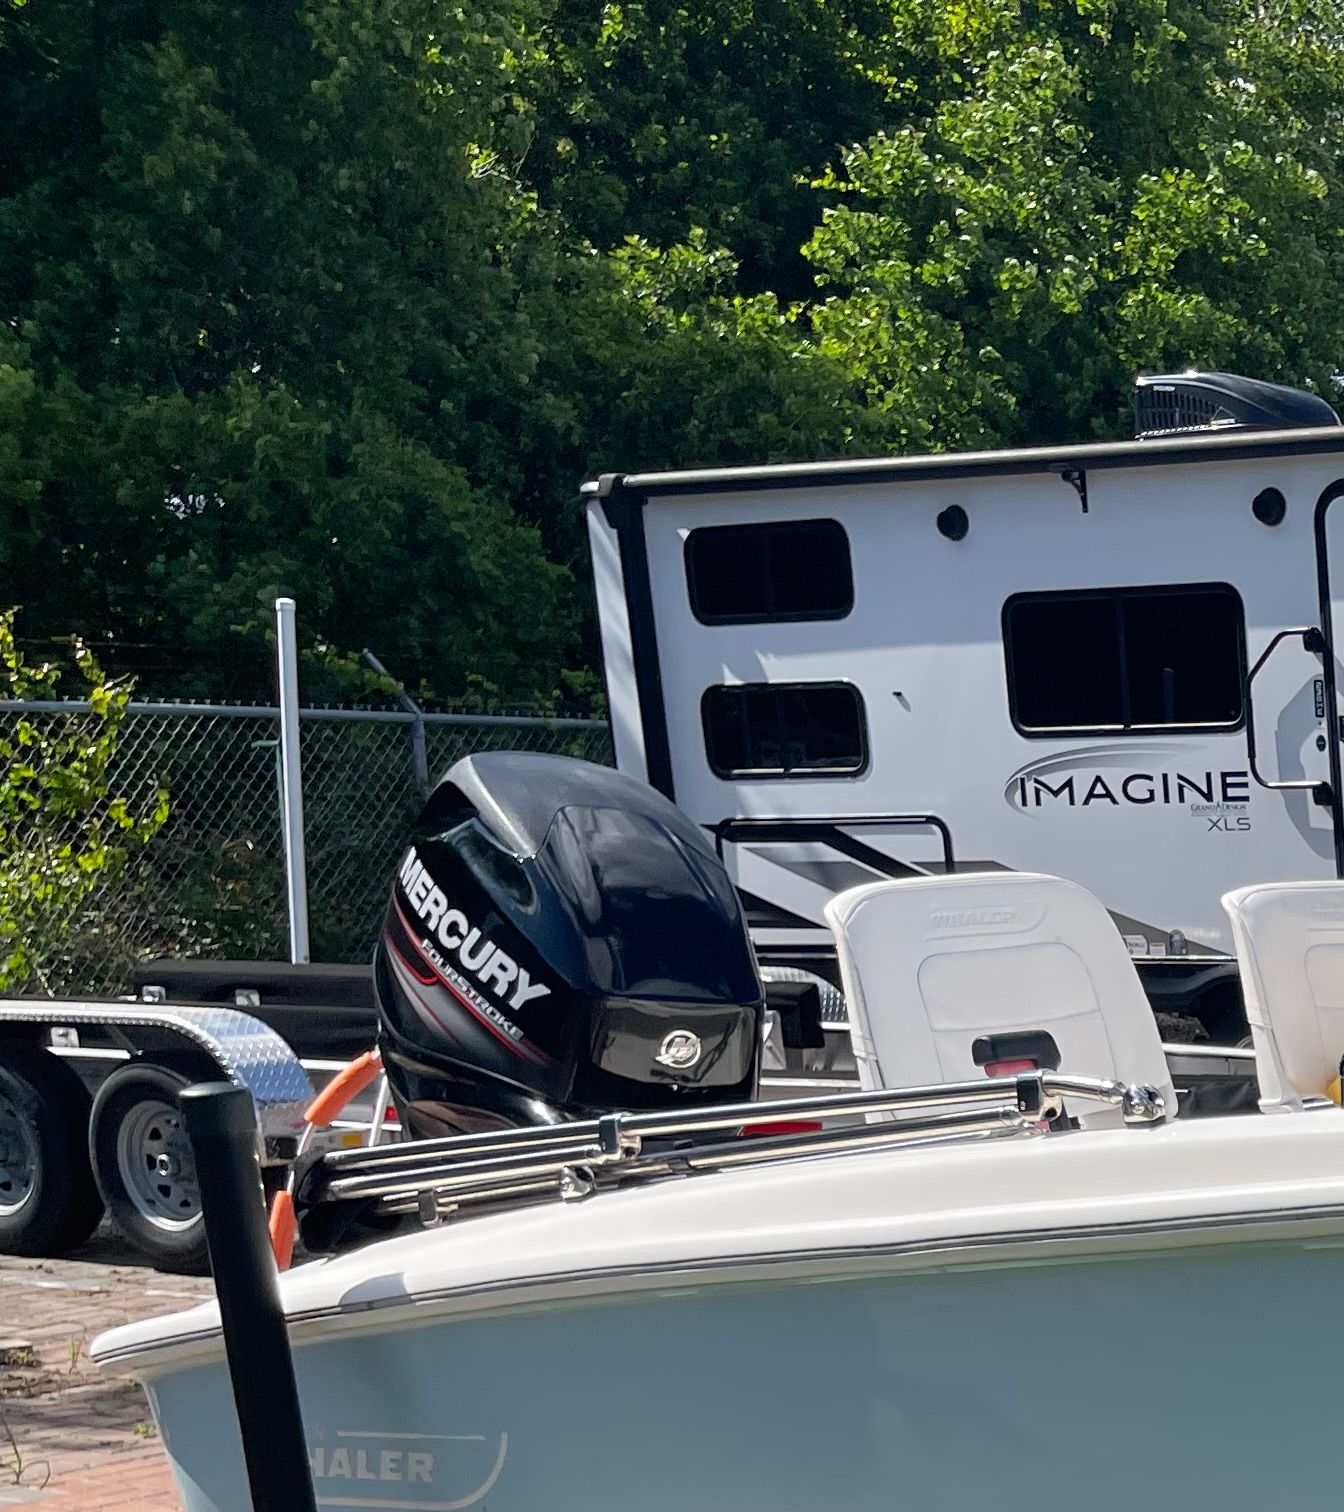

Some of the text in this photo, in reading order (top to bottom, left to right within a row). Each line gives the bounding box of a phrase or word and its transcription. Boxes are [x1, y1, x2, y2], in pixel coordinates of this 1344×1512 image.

[1018, 770, 1251, 807] IMAGINE
[1207, 817, 1251, 831] XLS
[399, 846, 552, 1011] MERCURY
[421, 937, 525, 1041] FOURSTROKE
[310, 1447, 434, 1482] HALER
